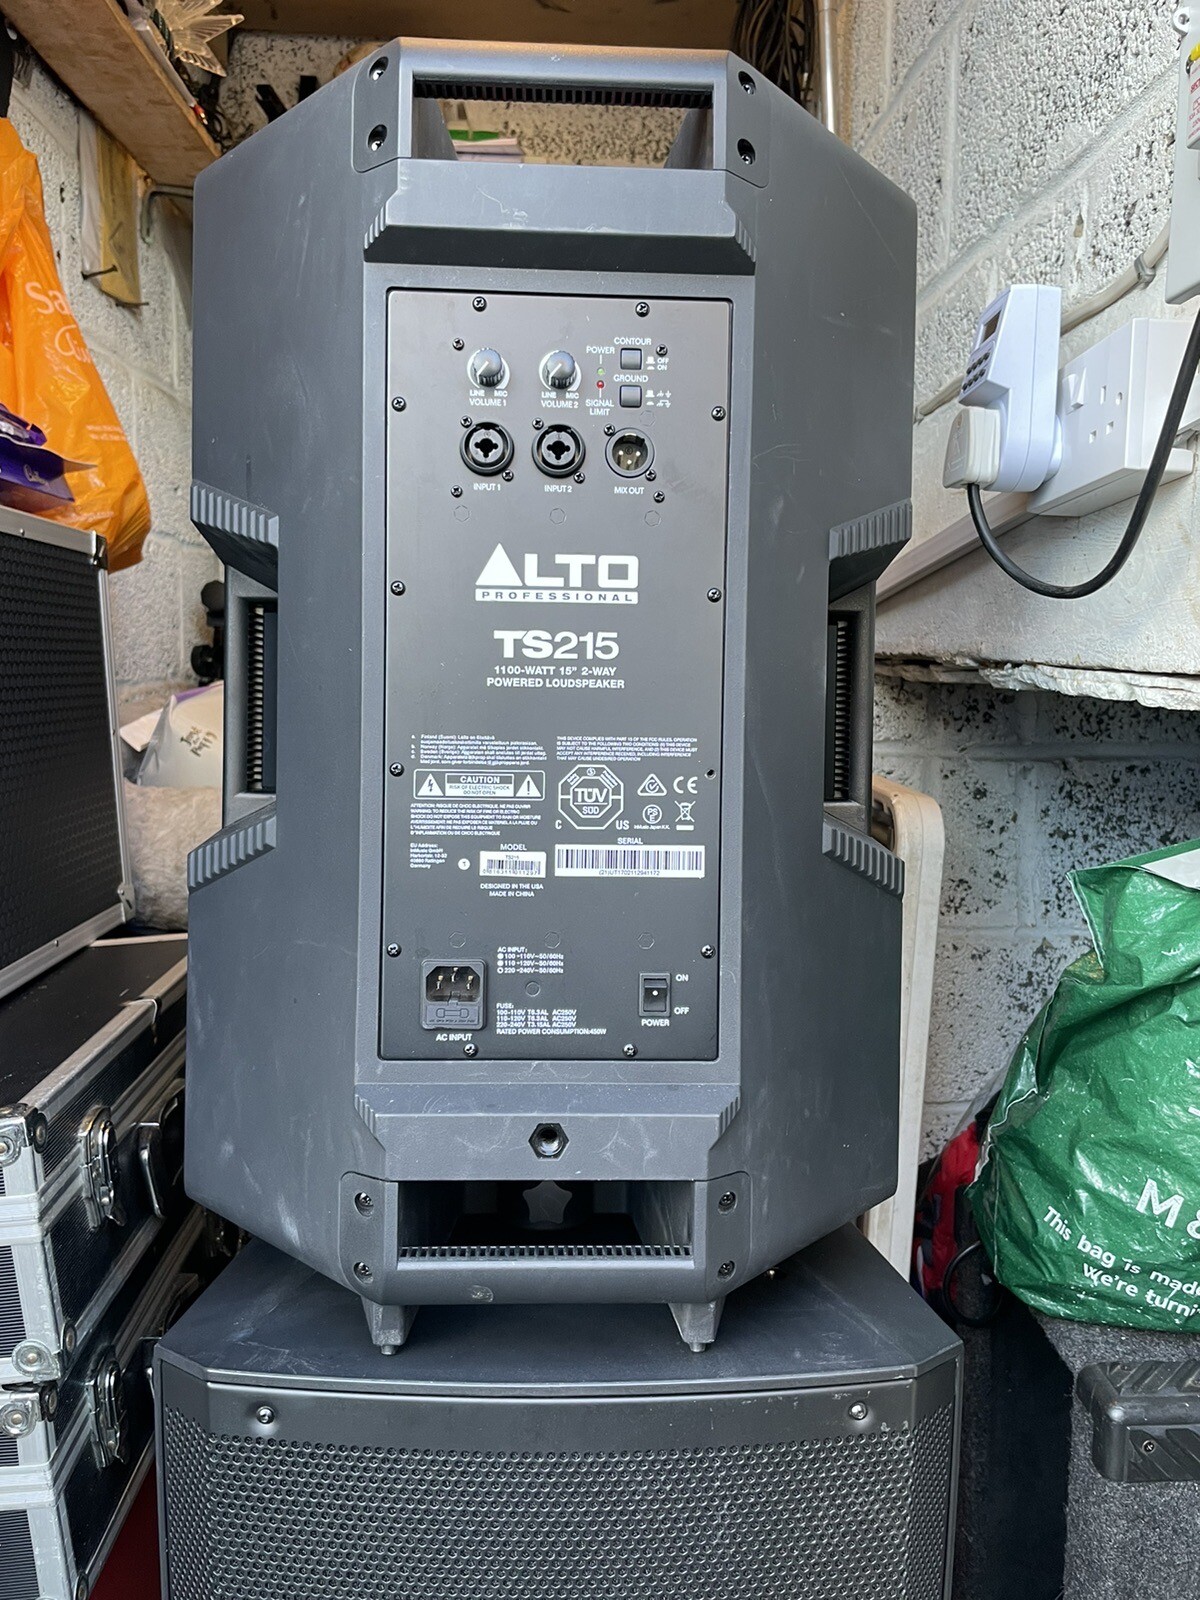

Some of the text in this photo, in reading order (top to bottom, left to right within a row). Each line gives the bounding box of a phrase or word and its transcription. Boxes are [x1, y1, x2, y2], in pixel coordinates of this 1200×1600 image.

[614, 338, 652, 346] CONTOUR
[614, 374, 648, 382] GROUND
[541, 400, 573, 408] VOLUME
[586, 399, 614, 407] SIGNAL
[482, 591, 632, 602] PROFESSIONAL
[494, 630, 619, 660] TS215
[494, 666, 555, 676] 1100-WATT
[581, 667, 617, 676] 2-WAY
[487, 677, 625, 689] POWERED LOUDSPEAKER
[574, 788, 608, 803] TÜV
[582, 806, 599, 814] SÜD
[616, 820, 630, 830] US
[1043, 1206, 1072, 1241] This
[1077, 1235, 1116, 1268] bag
[1122, 1257, 1141, 1275] is
[1145, 1289, 1200, 1317] turni
